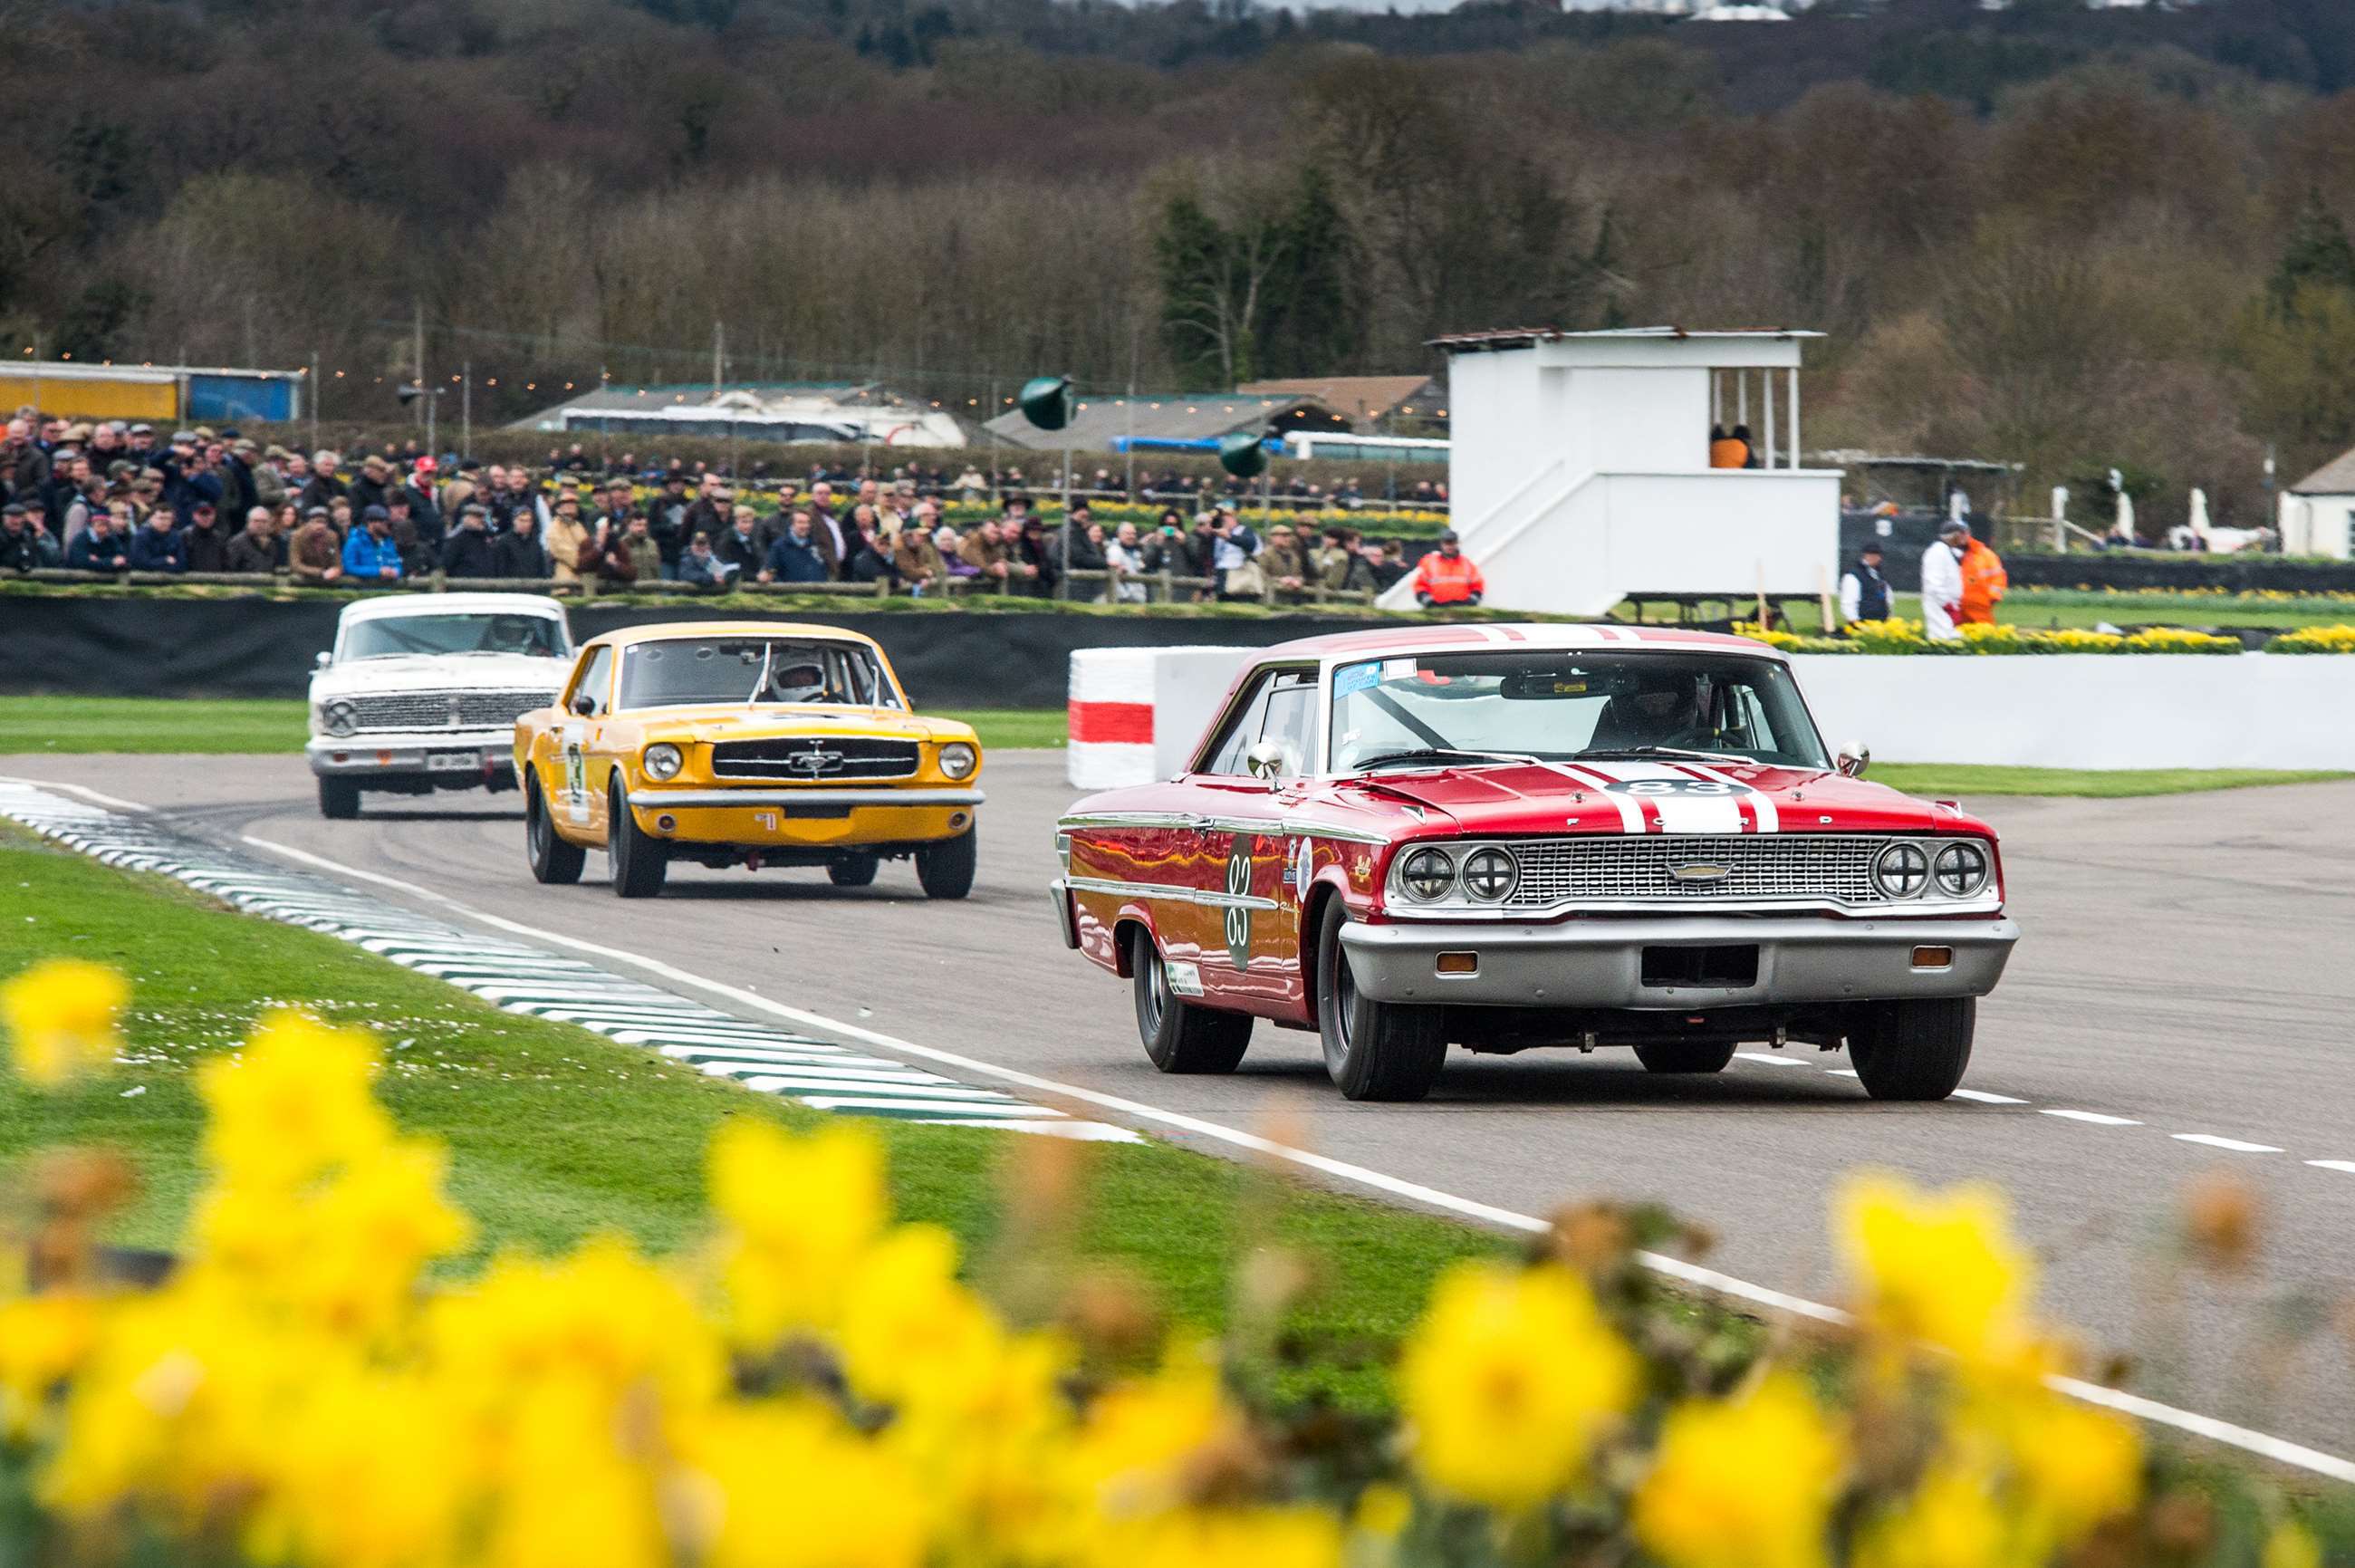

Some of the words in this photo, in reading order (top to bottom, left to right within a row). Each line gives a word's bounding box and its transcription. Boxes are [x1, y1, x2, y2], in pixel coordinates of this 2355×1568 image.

[1626, 781, 1732, 795] 83
[1566, 815, 1832, 826] FORD
[1226, 853, 1251, 948] 83
